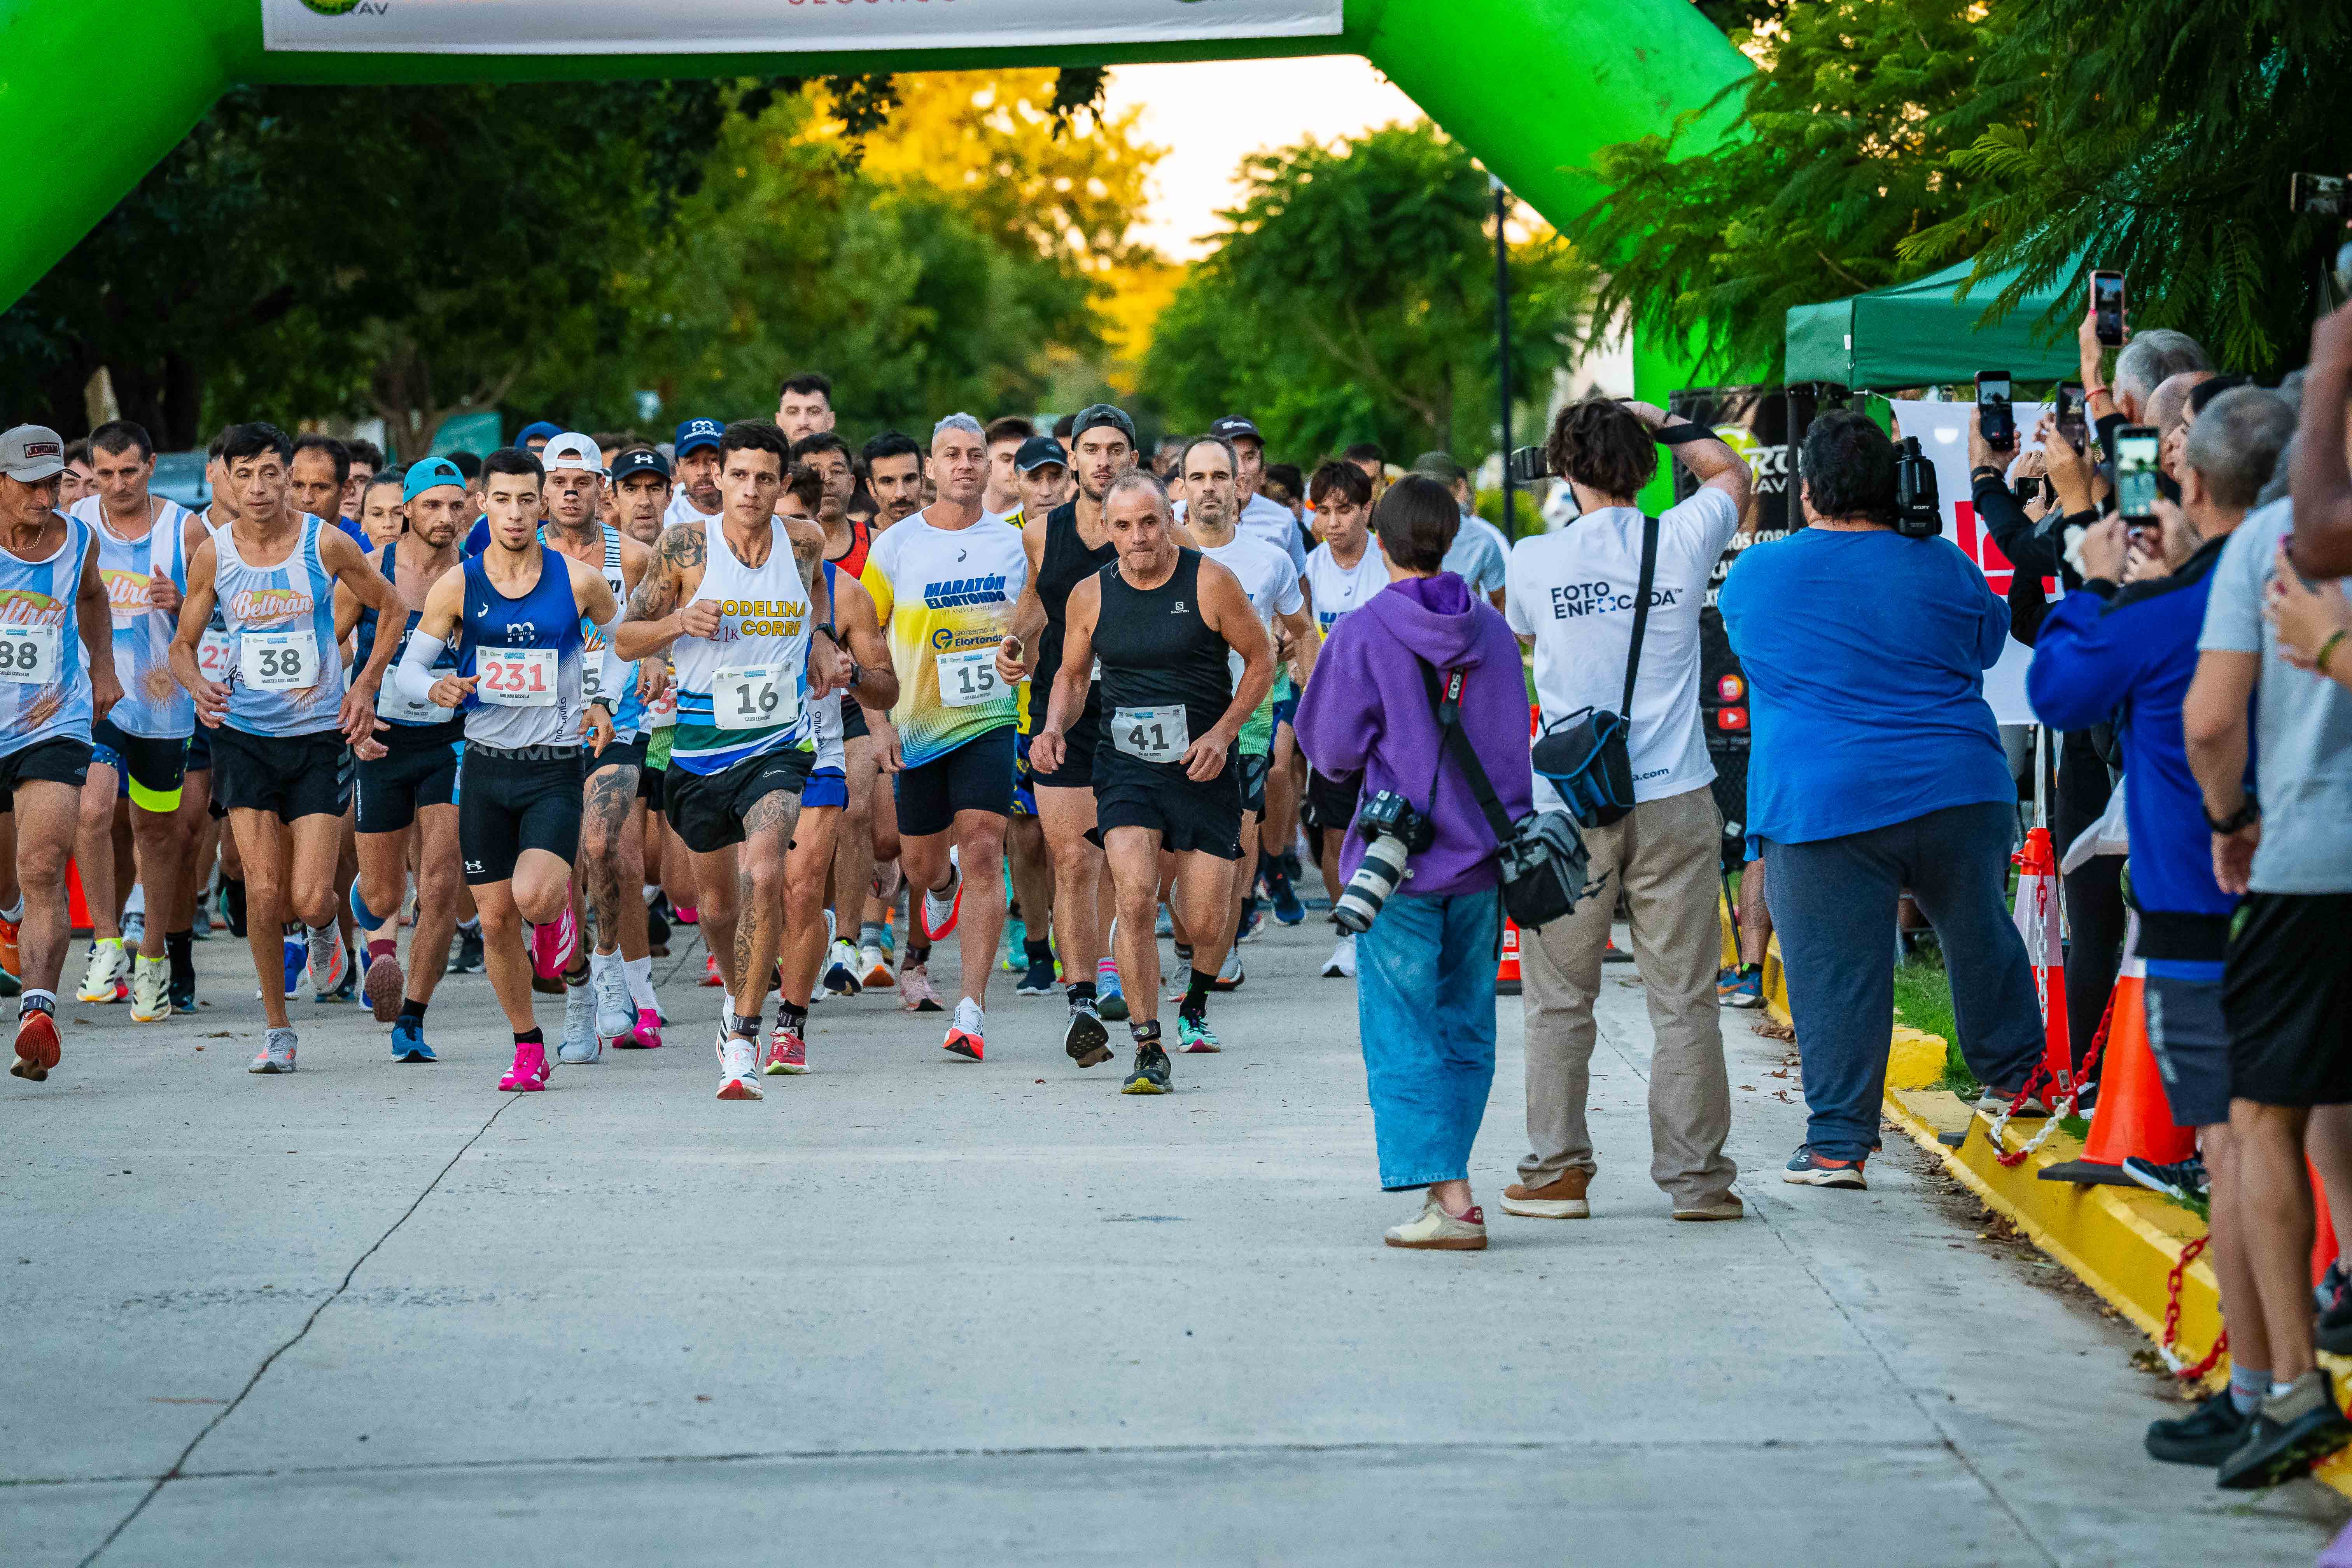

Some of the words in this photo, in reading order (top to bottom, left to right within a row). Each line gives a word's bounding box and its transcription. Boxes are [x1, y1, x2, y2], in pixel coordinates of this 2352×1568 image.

[26, 444, 60, 457] JORDAN
[924, 573, 1006, 598] MARATÓN
[1551, 581, 1610, 604] FOTO
[232, 592, 314, 620] Beltrán
[925, 590, 1006, 610] ELORTONDO
[955, 627, 988, 636] Gobierno
[259, 649, 301, 677] 38
[485, 662, 546, 691] 231
[957, 664, 994, 694] 15
[736, 682, 779, 714] 16
[1128, 723, 1170, 750] 41
[1633, 768, 1669, 781] a.com
